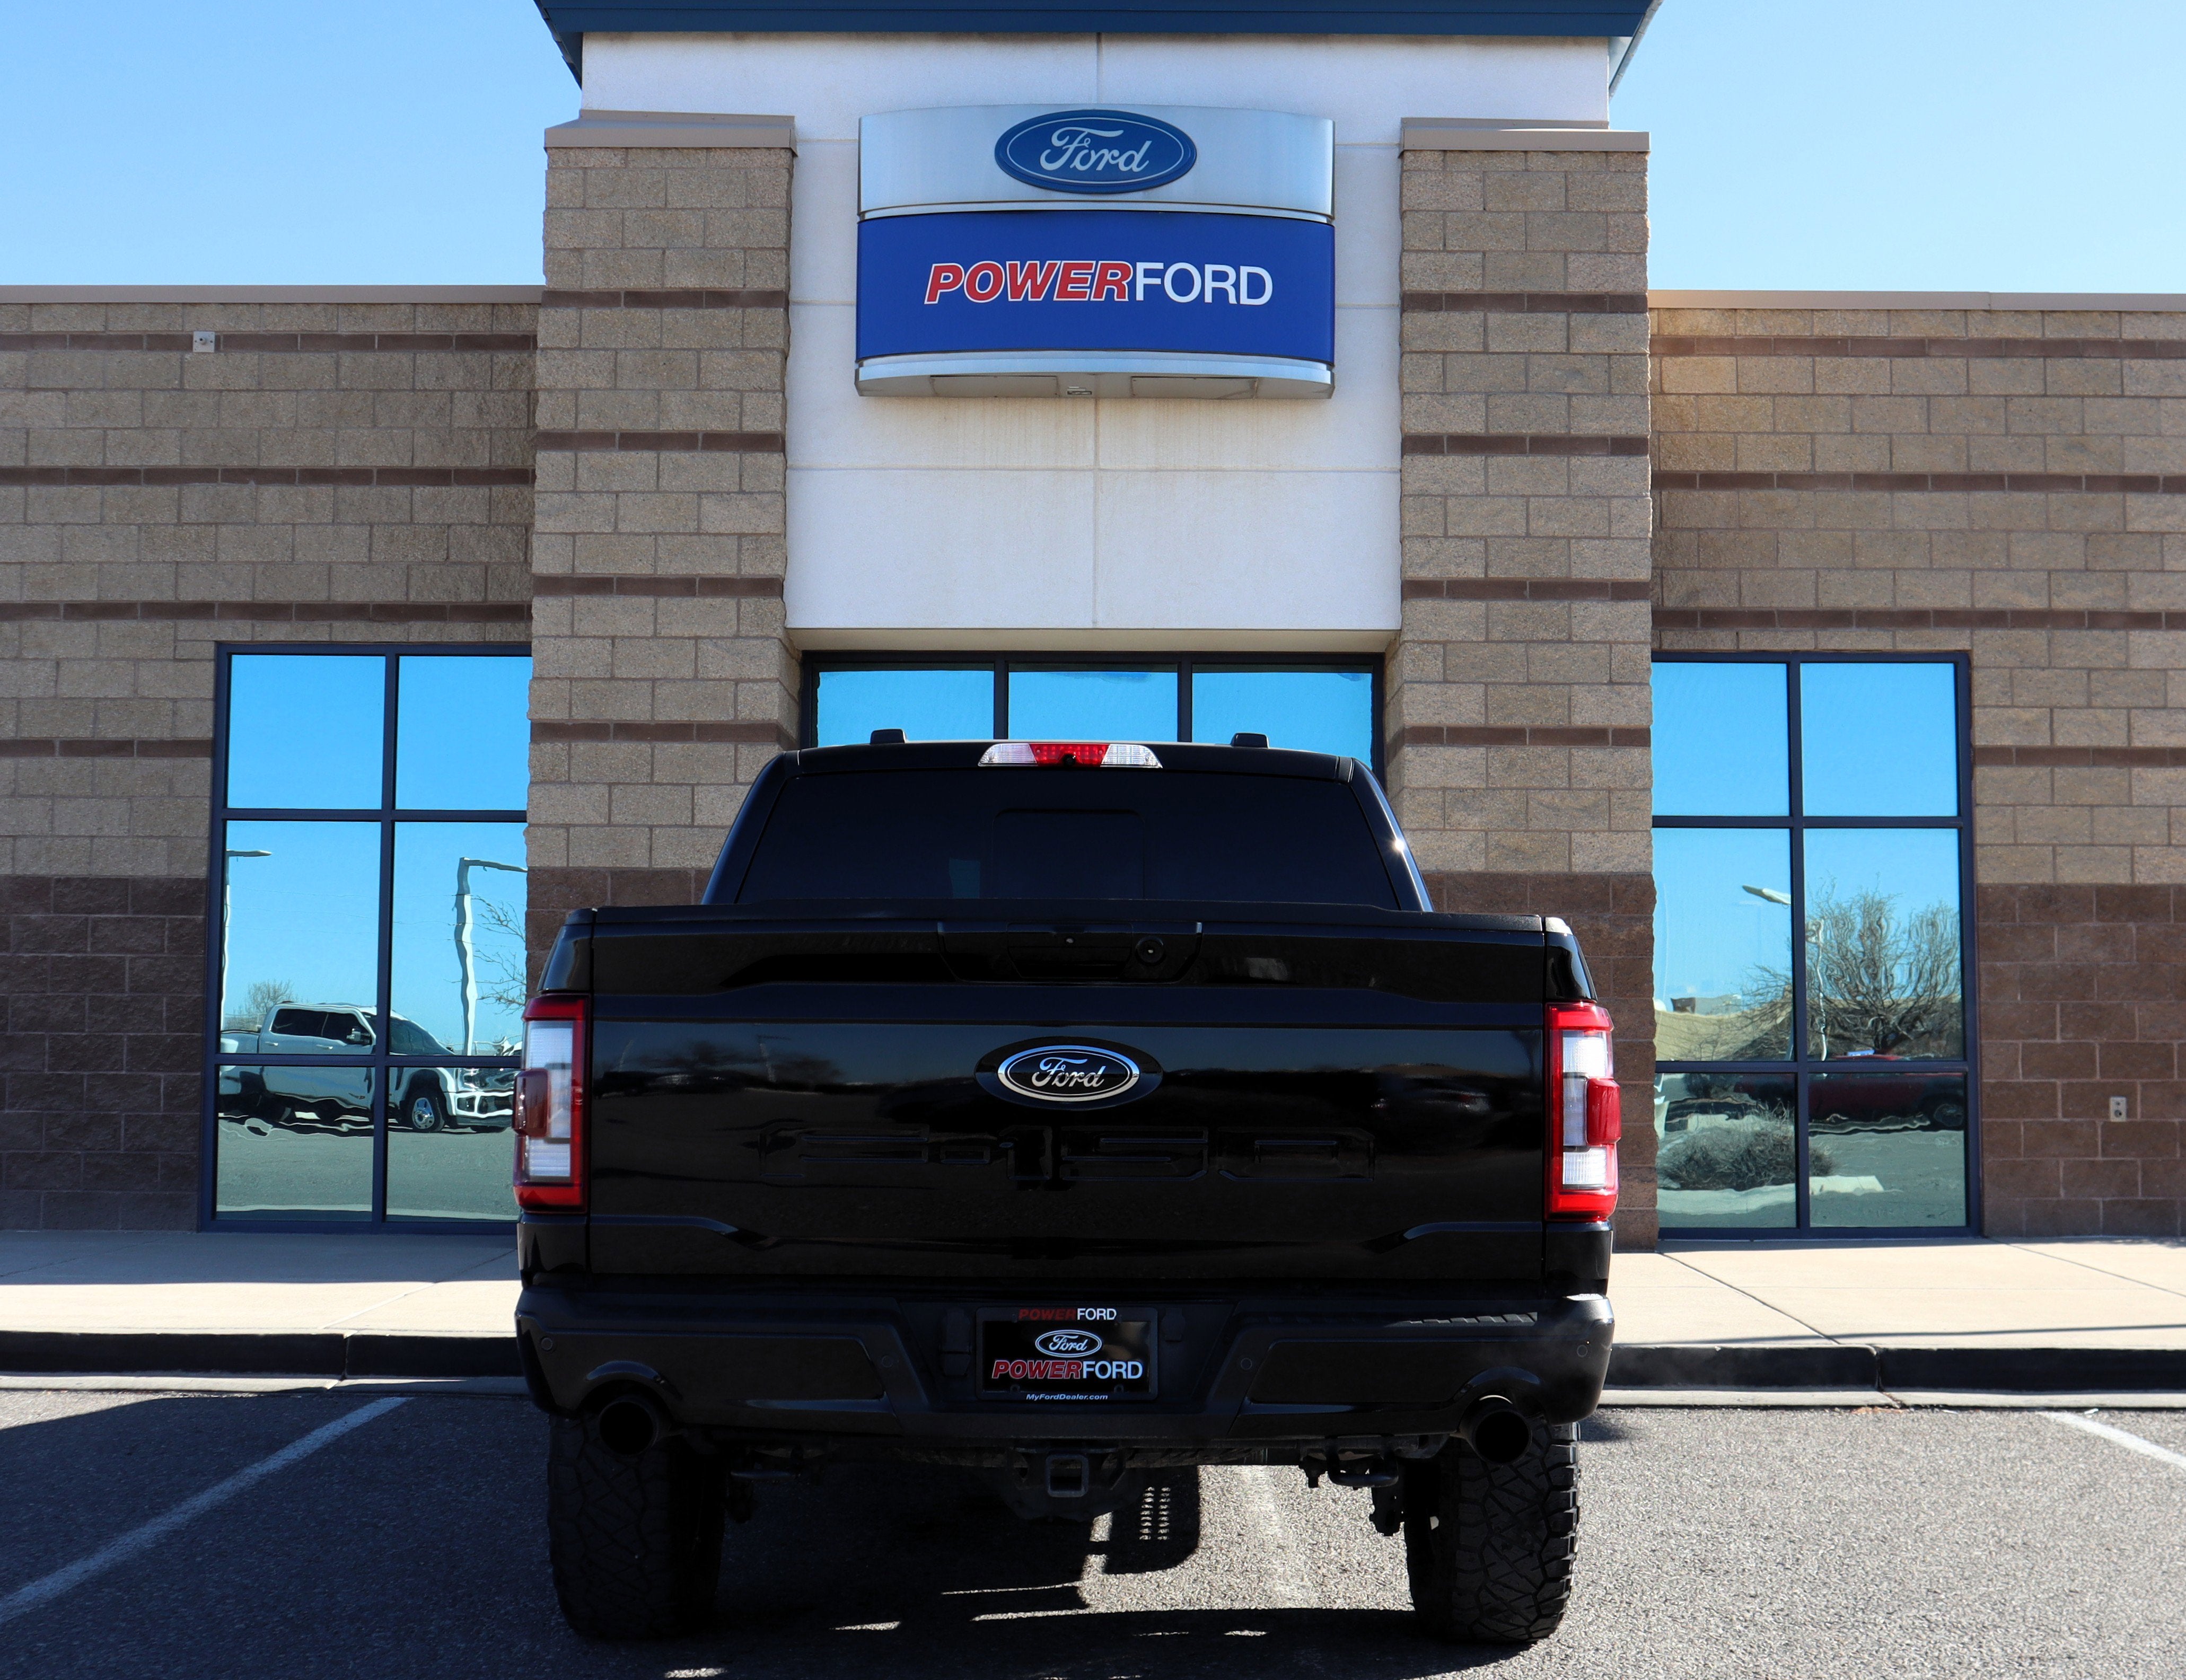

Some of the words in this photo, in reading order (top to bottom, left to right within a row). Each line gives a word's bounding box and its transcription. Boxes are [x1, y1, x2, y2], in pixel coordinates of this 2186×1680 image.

[1040, 127, 1152, 173] Ford
[1032, 1057, 1106, 1087] Ford
[1049, 1335, 1088, 1351] Ford
